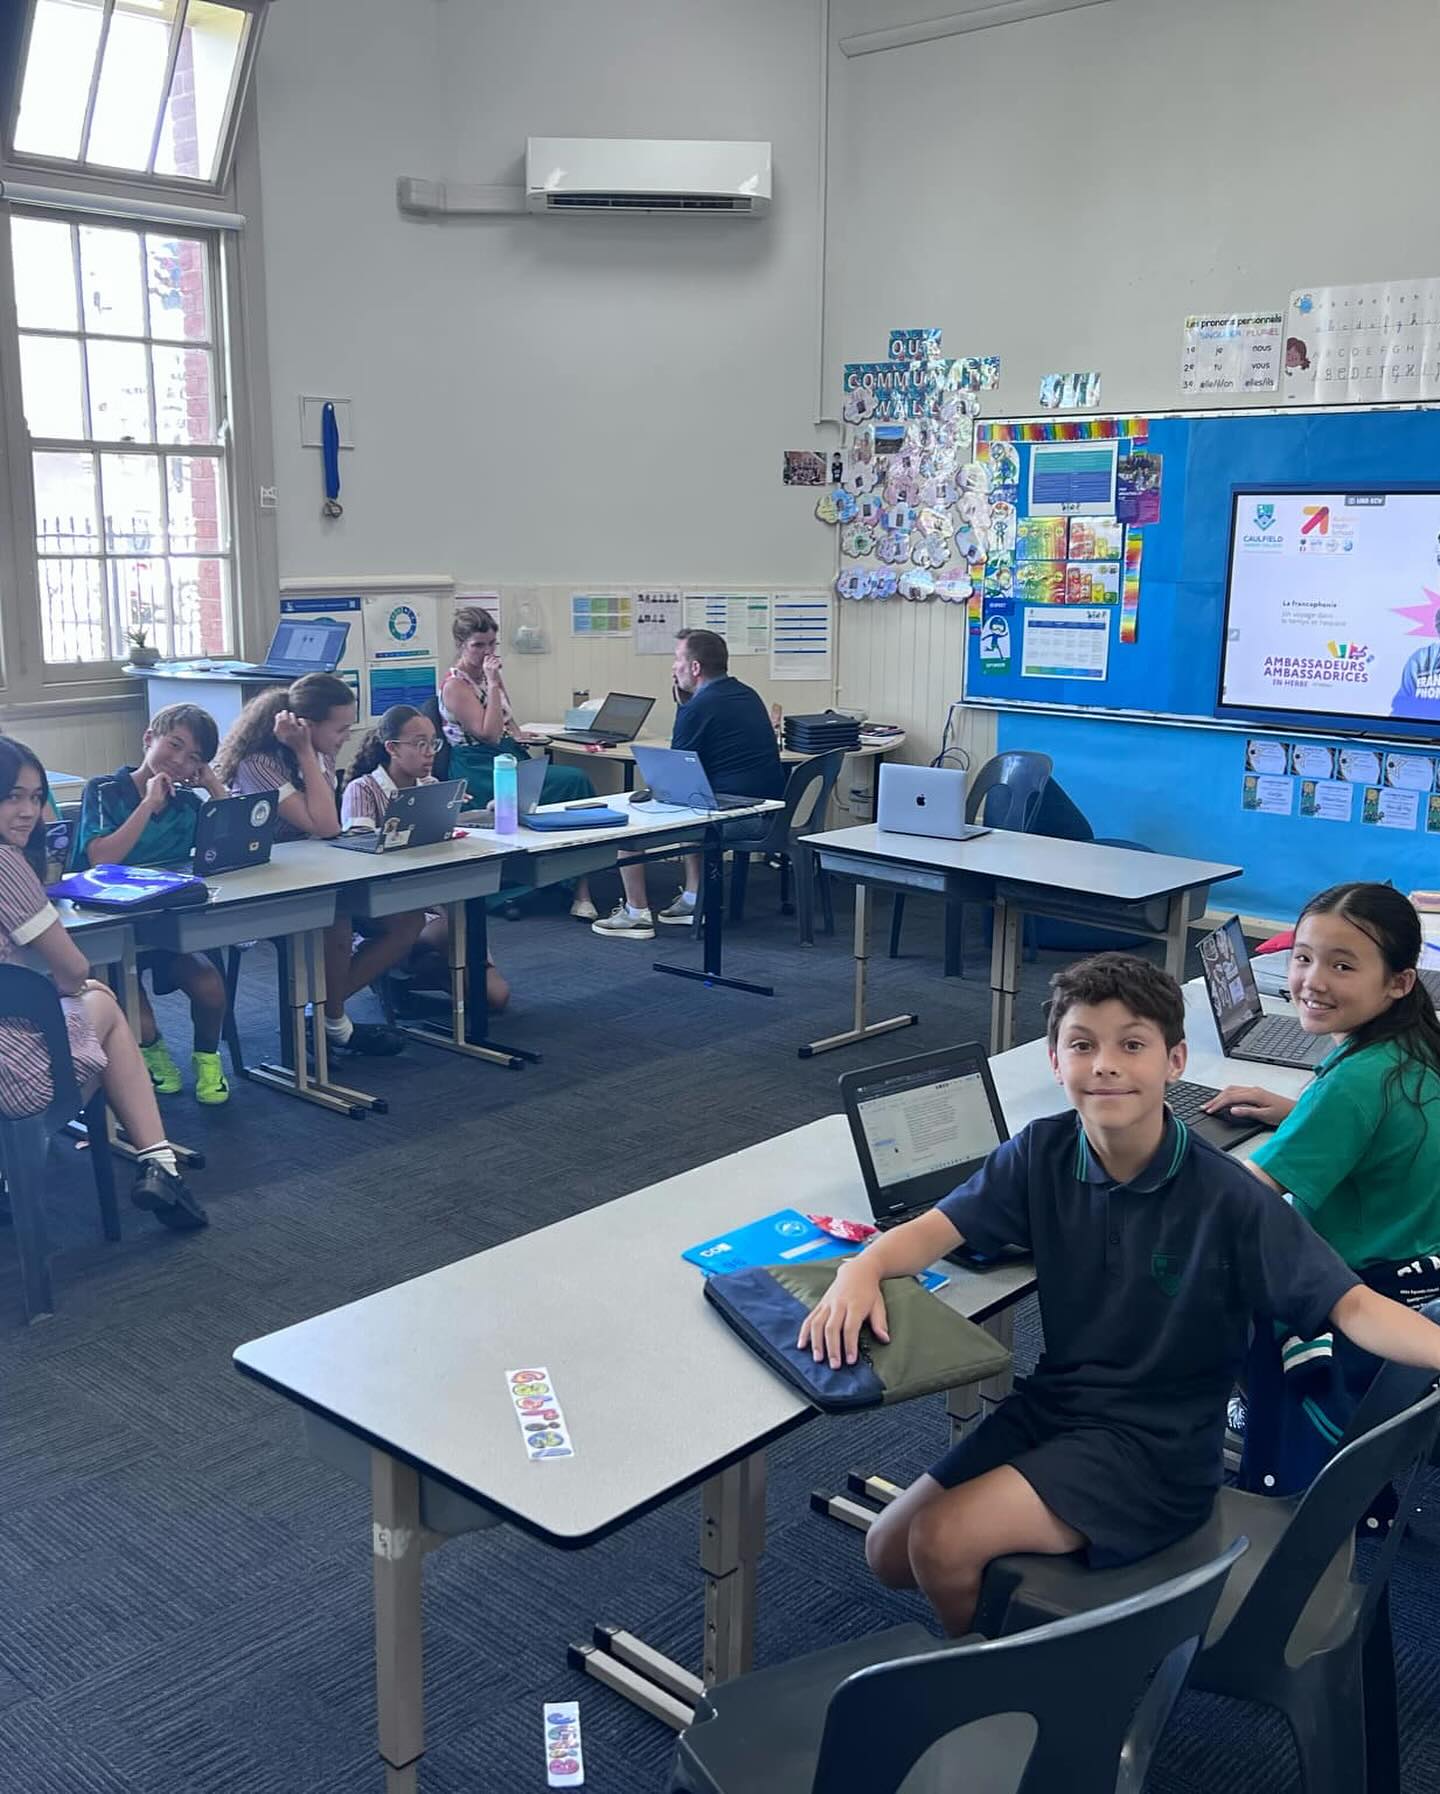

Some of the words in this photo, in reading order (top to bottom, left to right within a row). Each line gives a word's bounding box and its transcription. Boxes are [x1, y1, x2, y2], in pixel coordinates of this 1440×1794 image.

[876, 401, 940, 417] WALL
[1264, 656, 1365, 672] AMBASSADEURS
[1264, 668, 1369, 683] AMBASSADRICES
